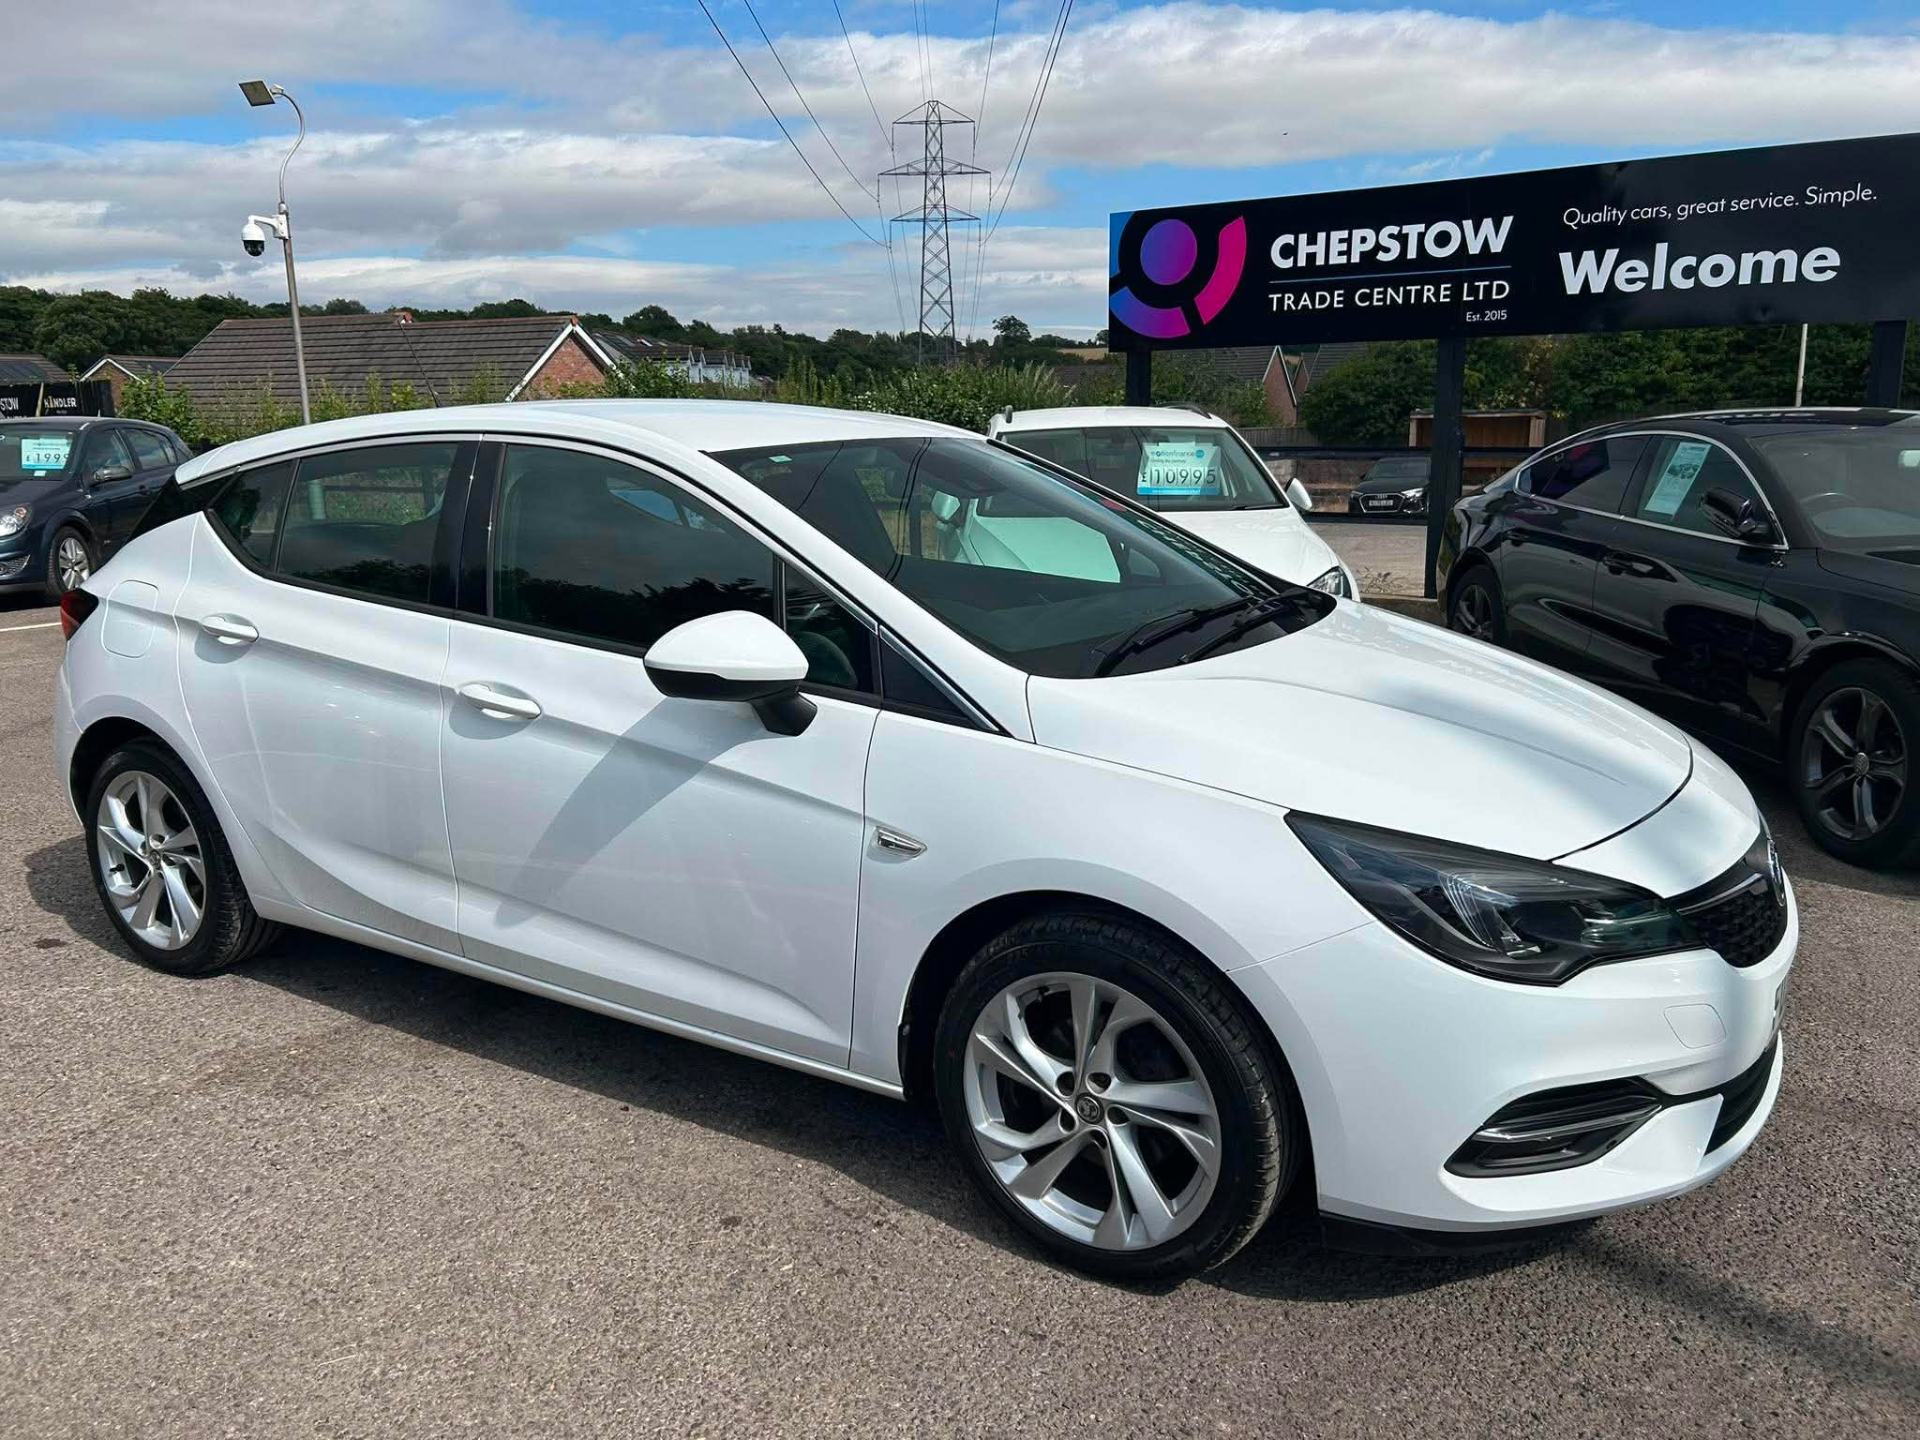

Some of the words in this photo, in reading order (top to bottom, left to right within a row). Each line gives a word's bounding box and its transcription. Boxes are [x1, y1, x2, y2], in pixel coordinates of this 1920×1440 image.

[1563, 205, 1627, 229] Quality
[1630, 202, 1672, 219] cars,
[1676, 198, 1726, 220] great
[1730, 192, 1799, 212] service.
[1805, 183, 1877, 207] Simple.
[1270, 215, 1514, 269] CHEPSTOW
[1558, 242, 1841, 295] Welcome
[1268, 290, 1345, 312] TRADE
[1354, 284, 1452, 307] CENTRE
[1462, 280, 1510, 302] LTD
[1466, 311, 1482, 322] Est.
[1484, 309, 1508, 322] 2015
[1141, 469, 1216, 485] £10995
